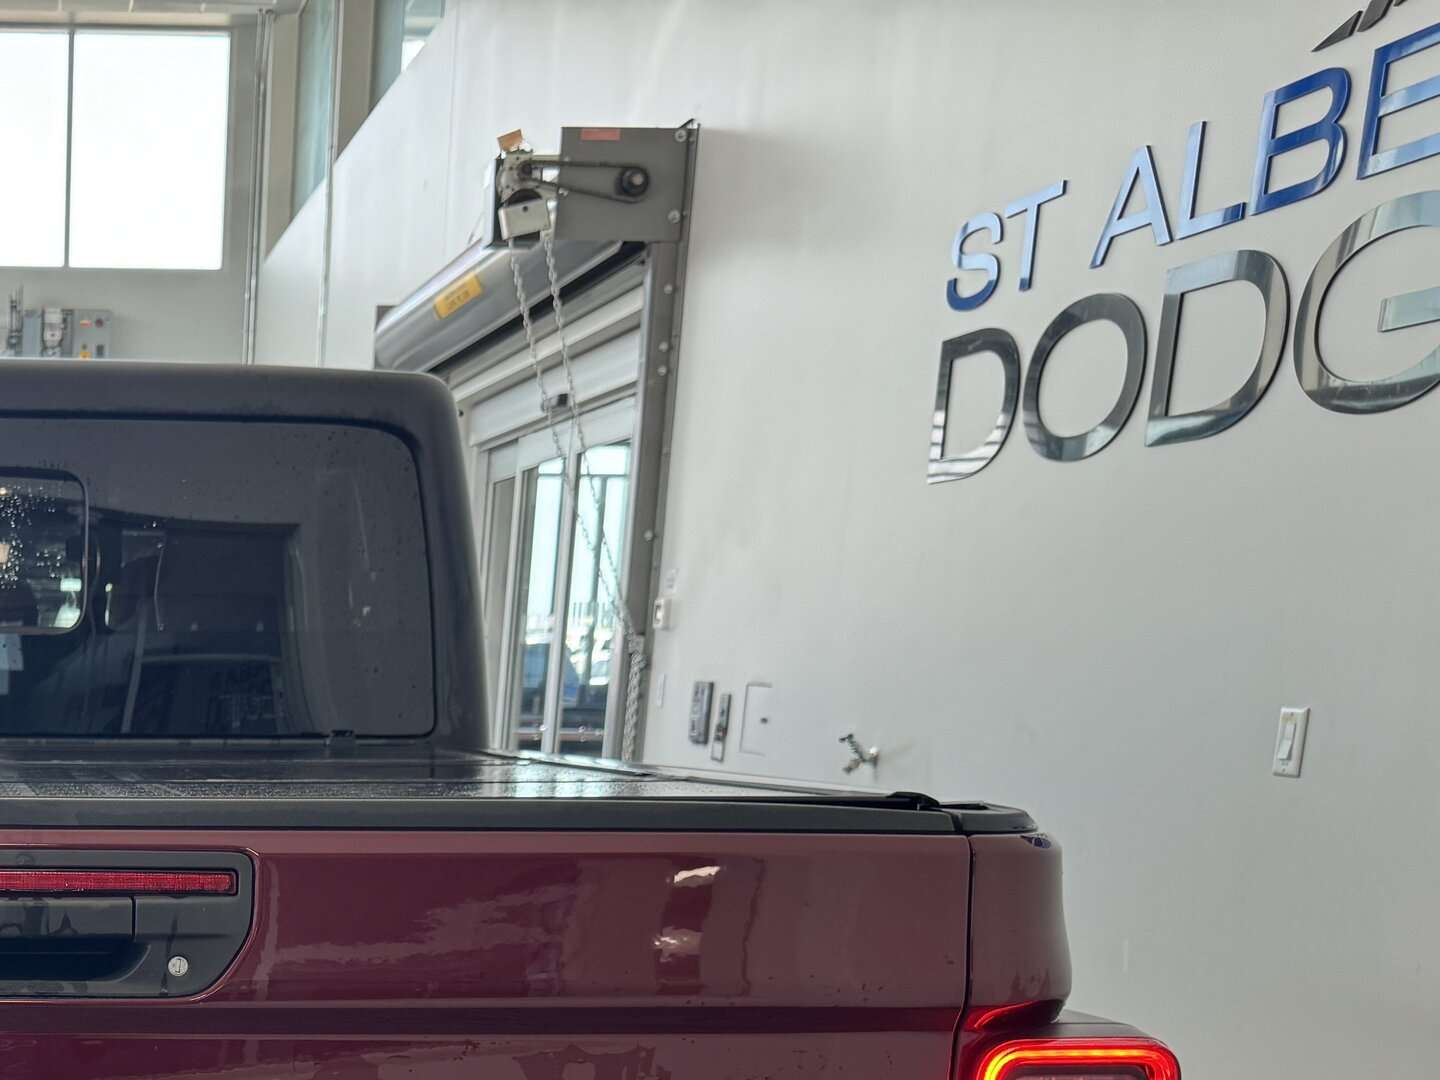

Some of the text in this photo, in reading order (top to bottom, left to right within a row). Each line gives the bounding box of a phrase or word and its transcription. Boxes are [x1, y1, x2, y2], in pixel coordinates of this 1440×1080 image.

[946, 22, 1440, 312] ST ALBE
[927, 190, 1440, 485] DODG
